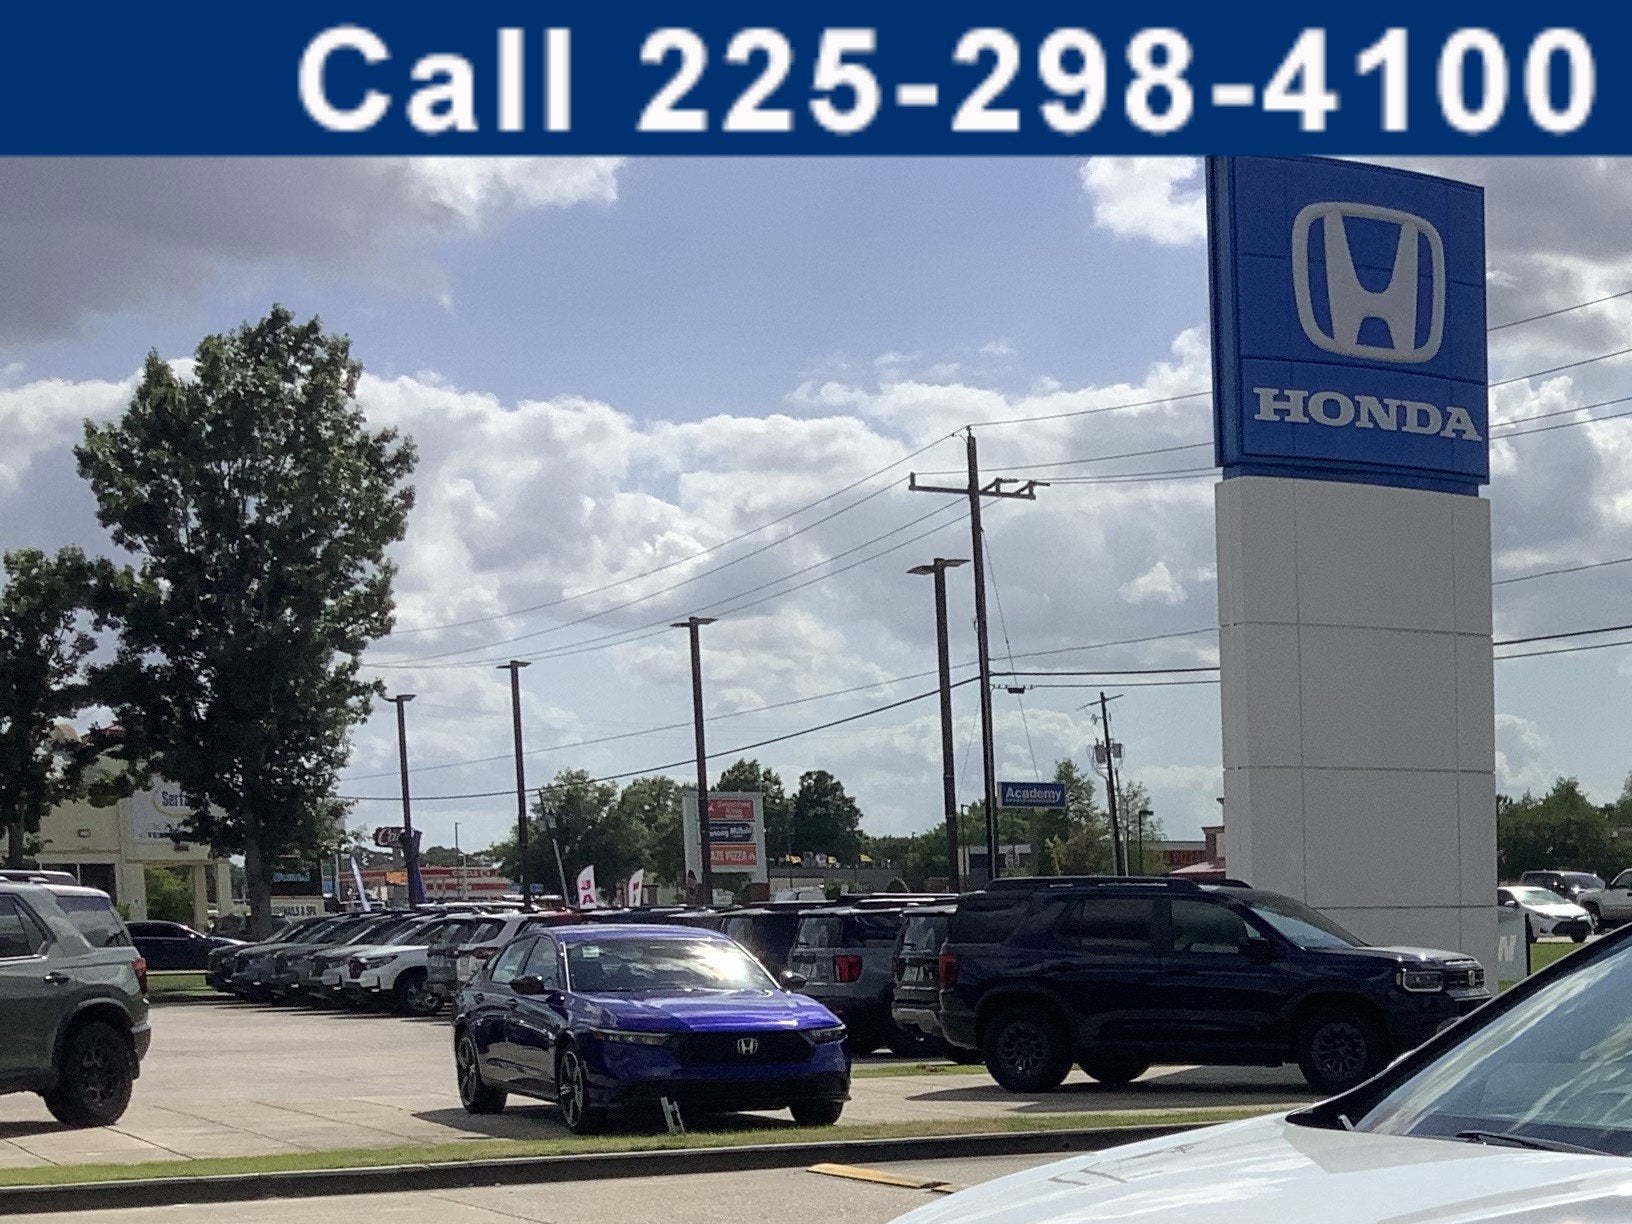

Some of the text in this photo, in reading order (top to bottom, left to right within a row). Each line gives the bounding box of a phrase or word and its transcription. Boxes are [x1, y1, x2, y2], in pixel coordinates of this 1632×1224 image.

[1253, 386, 1483, 442] HONDA
[161, 790, 192, 806] Sert
[1005, 786, 1062, 802] Academy
